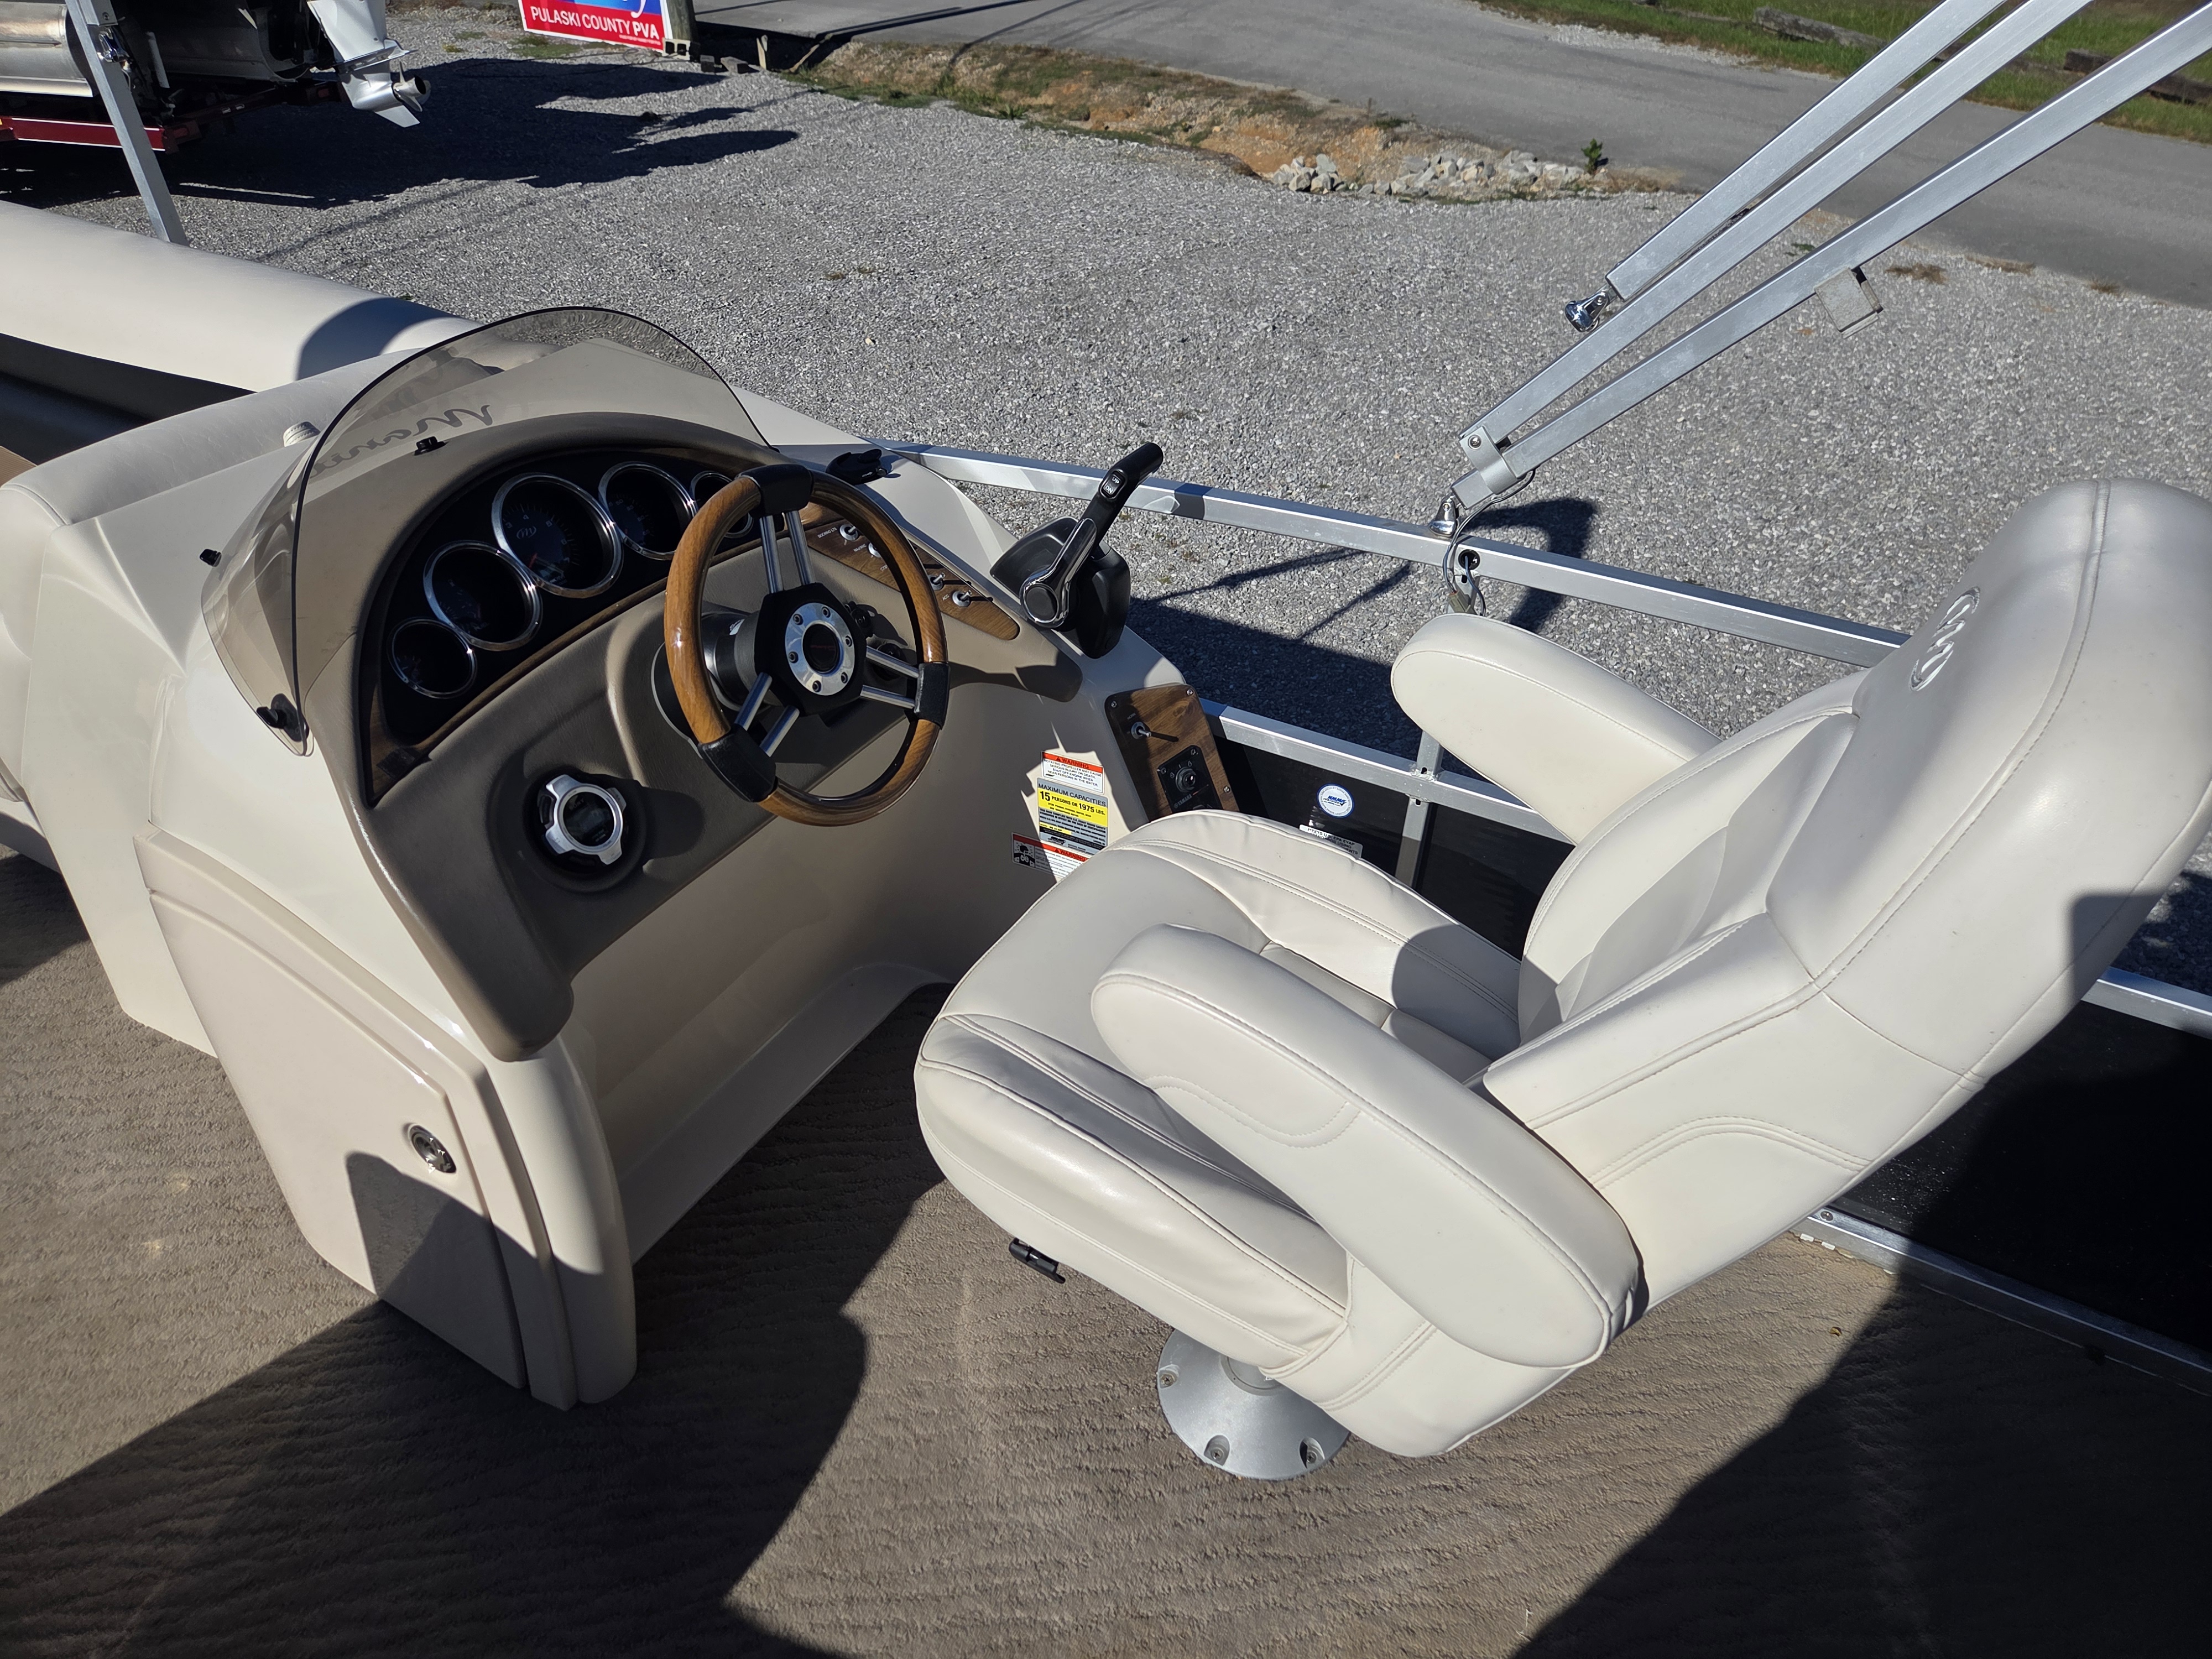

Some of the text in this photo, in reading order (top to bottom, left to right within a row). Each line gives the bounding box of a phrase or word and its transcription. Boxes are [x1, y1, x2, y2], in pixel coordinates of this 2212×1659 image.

[530, 6, 581, 27] PULASKI
[582, 13, 630, 34] COUNTY
[632, 21, 659, 40] PVA
[1062, 758, 1089, 769] WARNING
[1039, 783, 1106, 807] MAXIMUM CAPACITIES
[1040, 791, 1050, 801] 15
[1051, 796, 1071, 805] PERSONS
[1079, 803, 1094, 813] 1975
